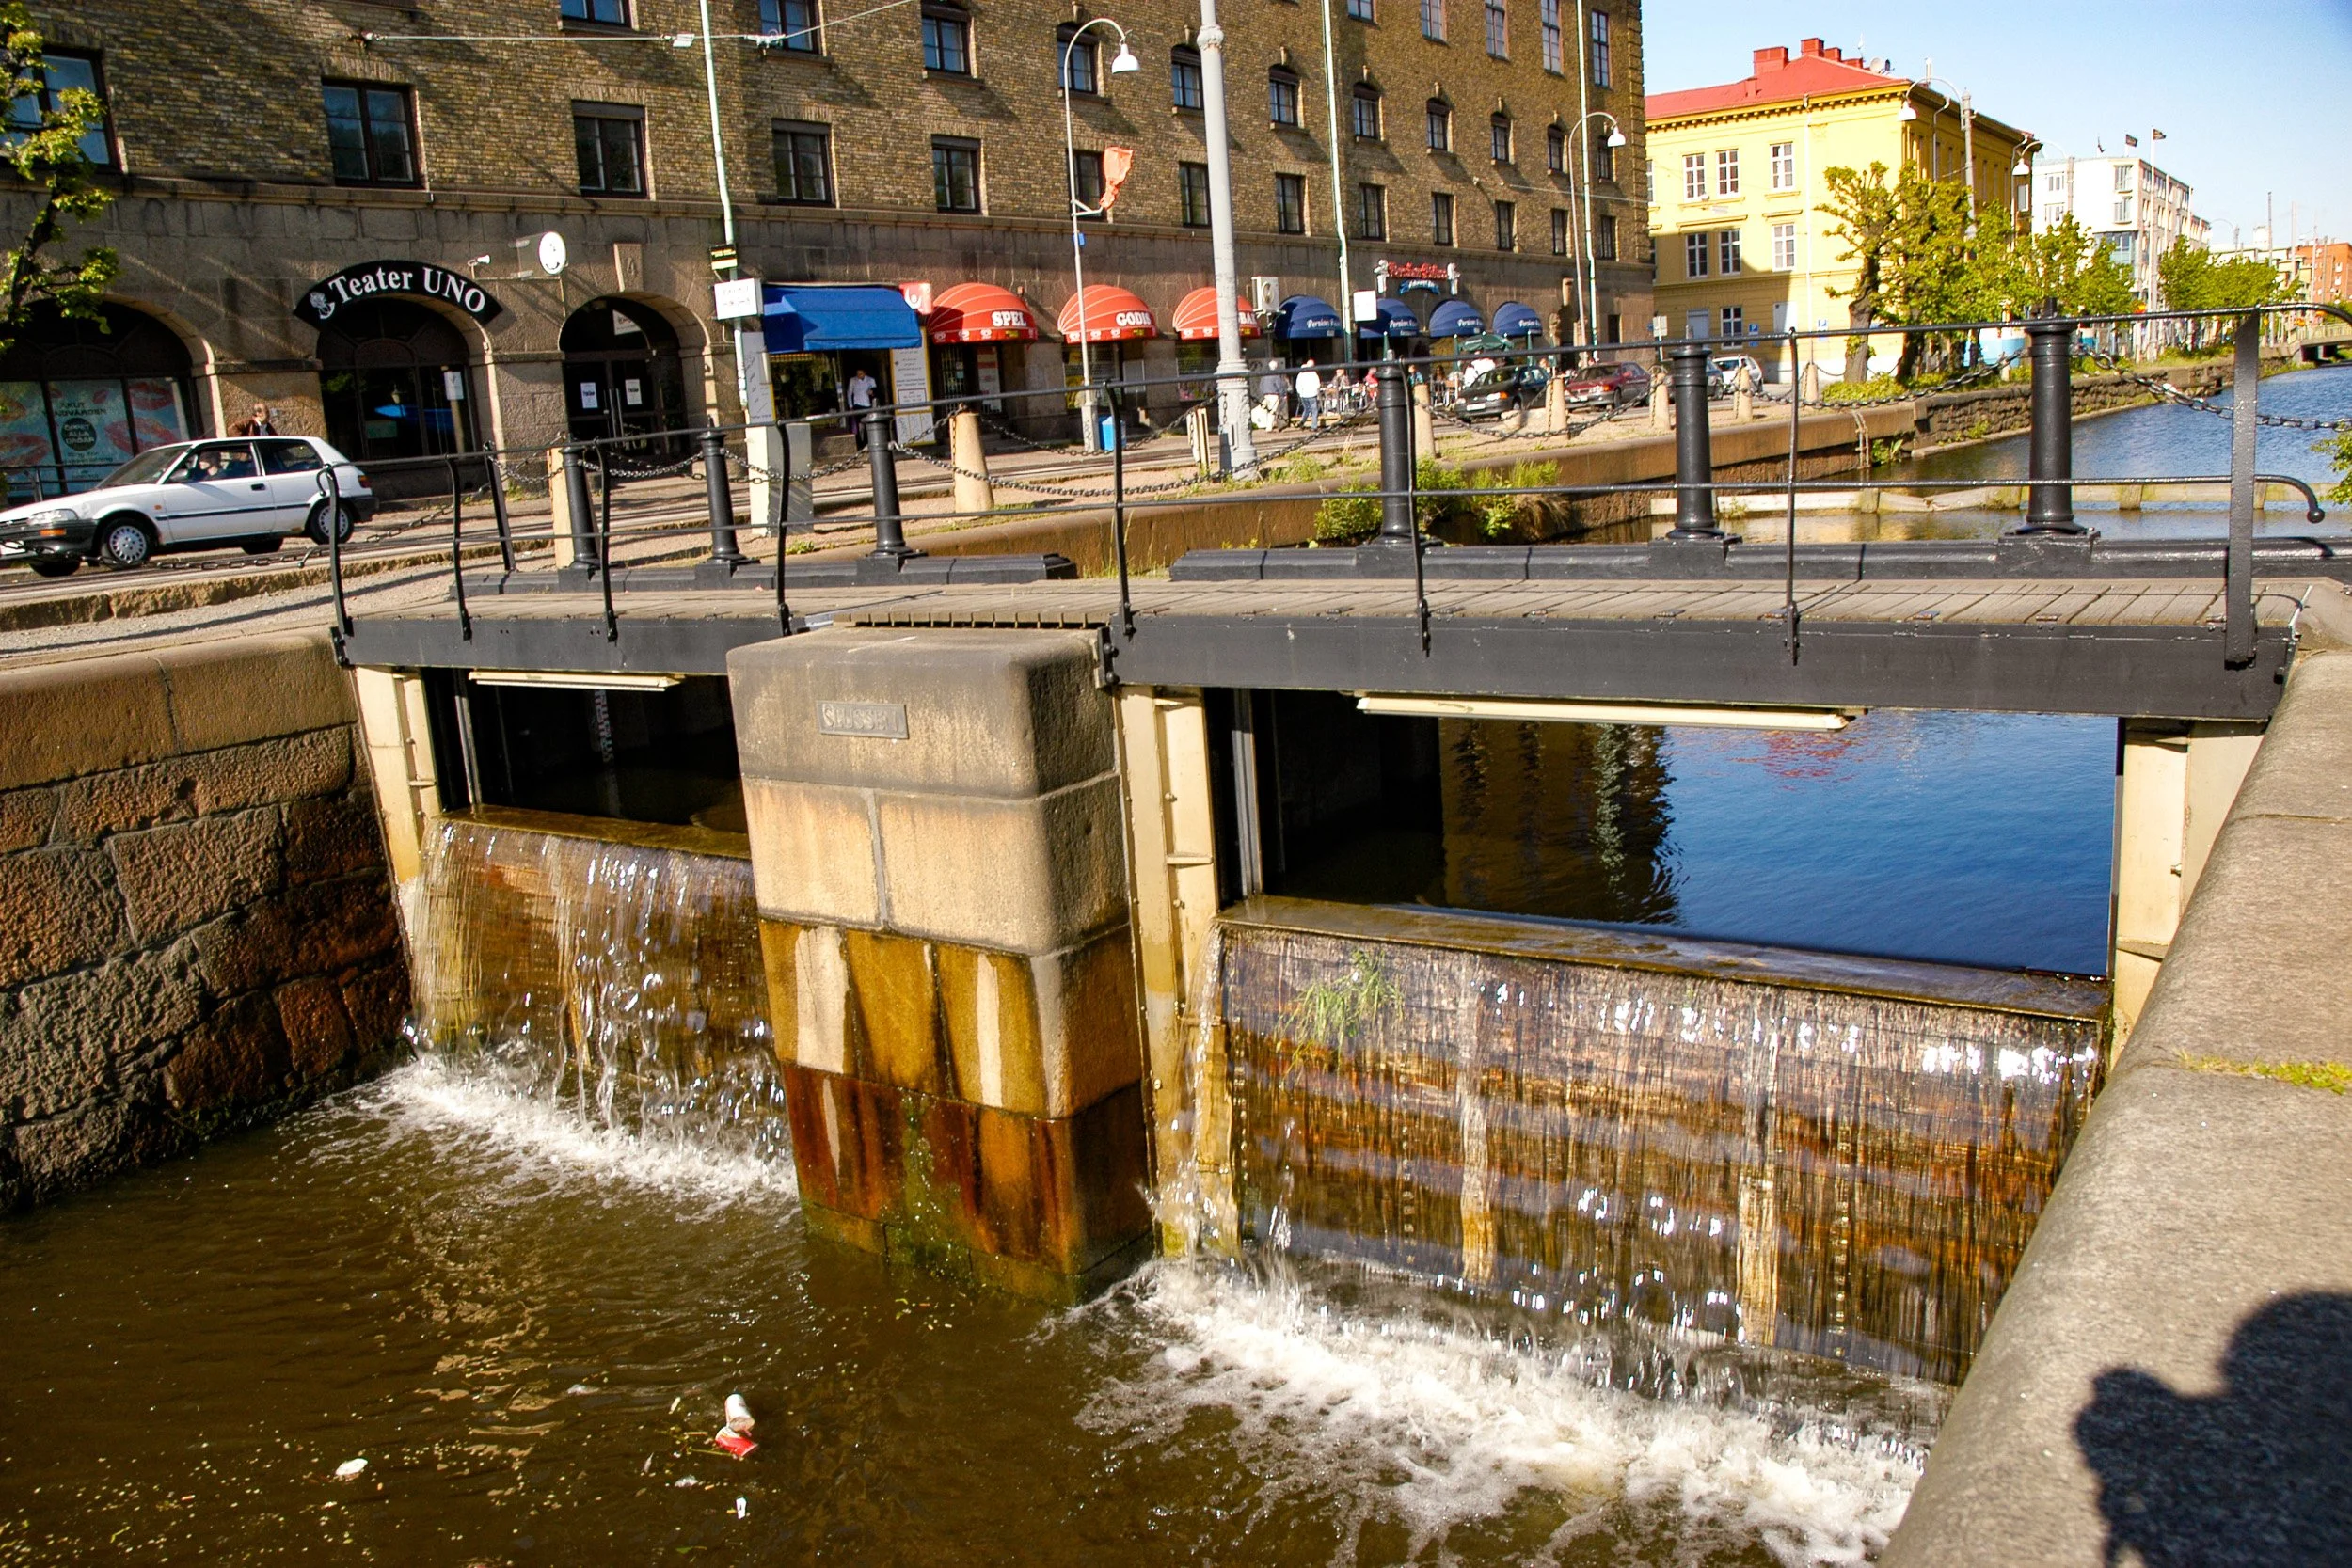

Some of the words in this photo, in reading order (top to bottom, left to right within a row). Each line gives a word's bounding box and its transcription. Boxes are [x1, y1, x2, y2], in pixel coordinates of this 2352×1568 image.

[327, 266, 413, 305] Teater
[421, 266, 486, 313] UNO
[991, 311, 1027, 327] SPEL
[1115, 311, 1152, 327] GODIS
